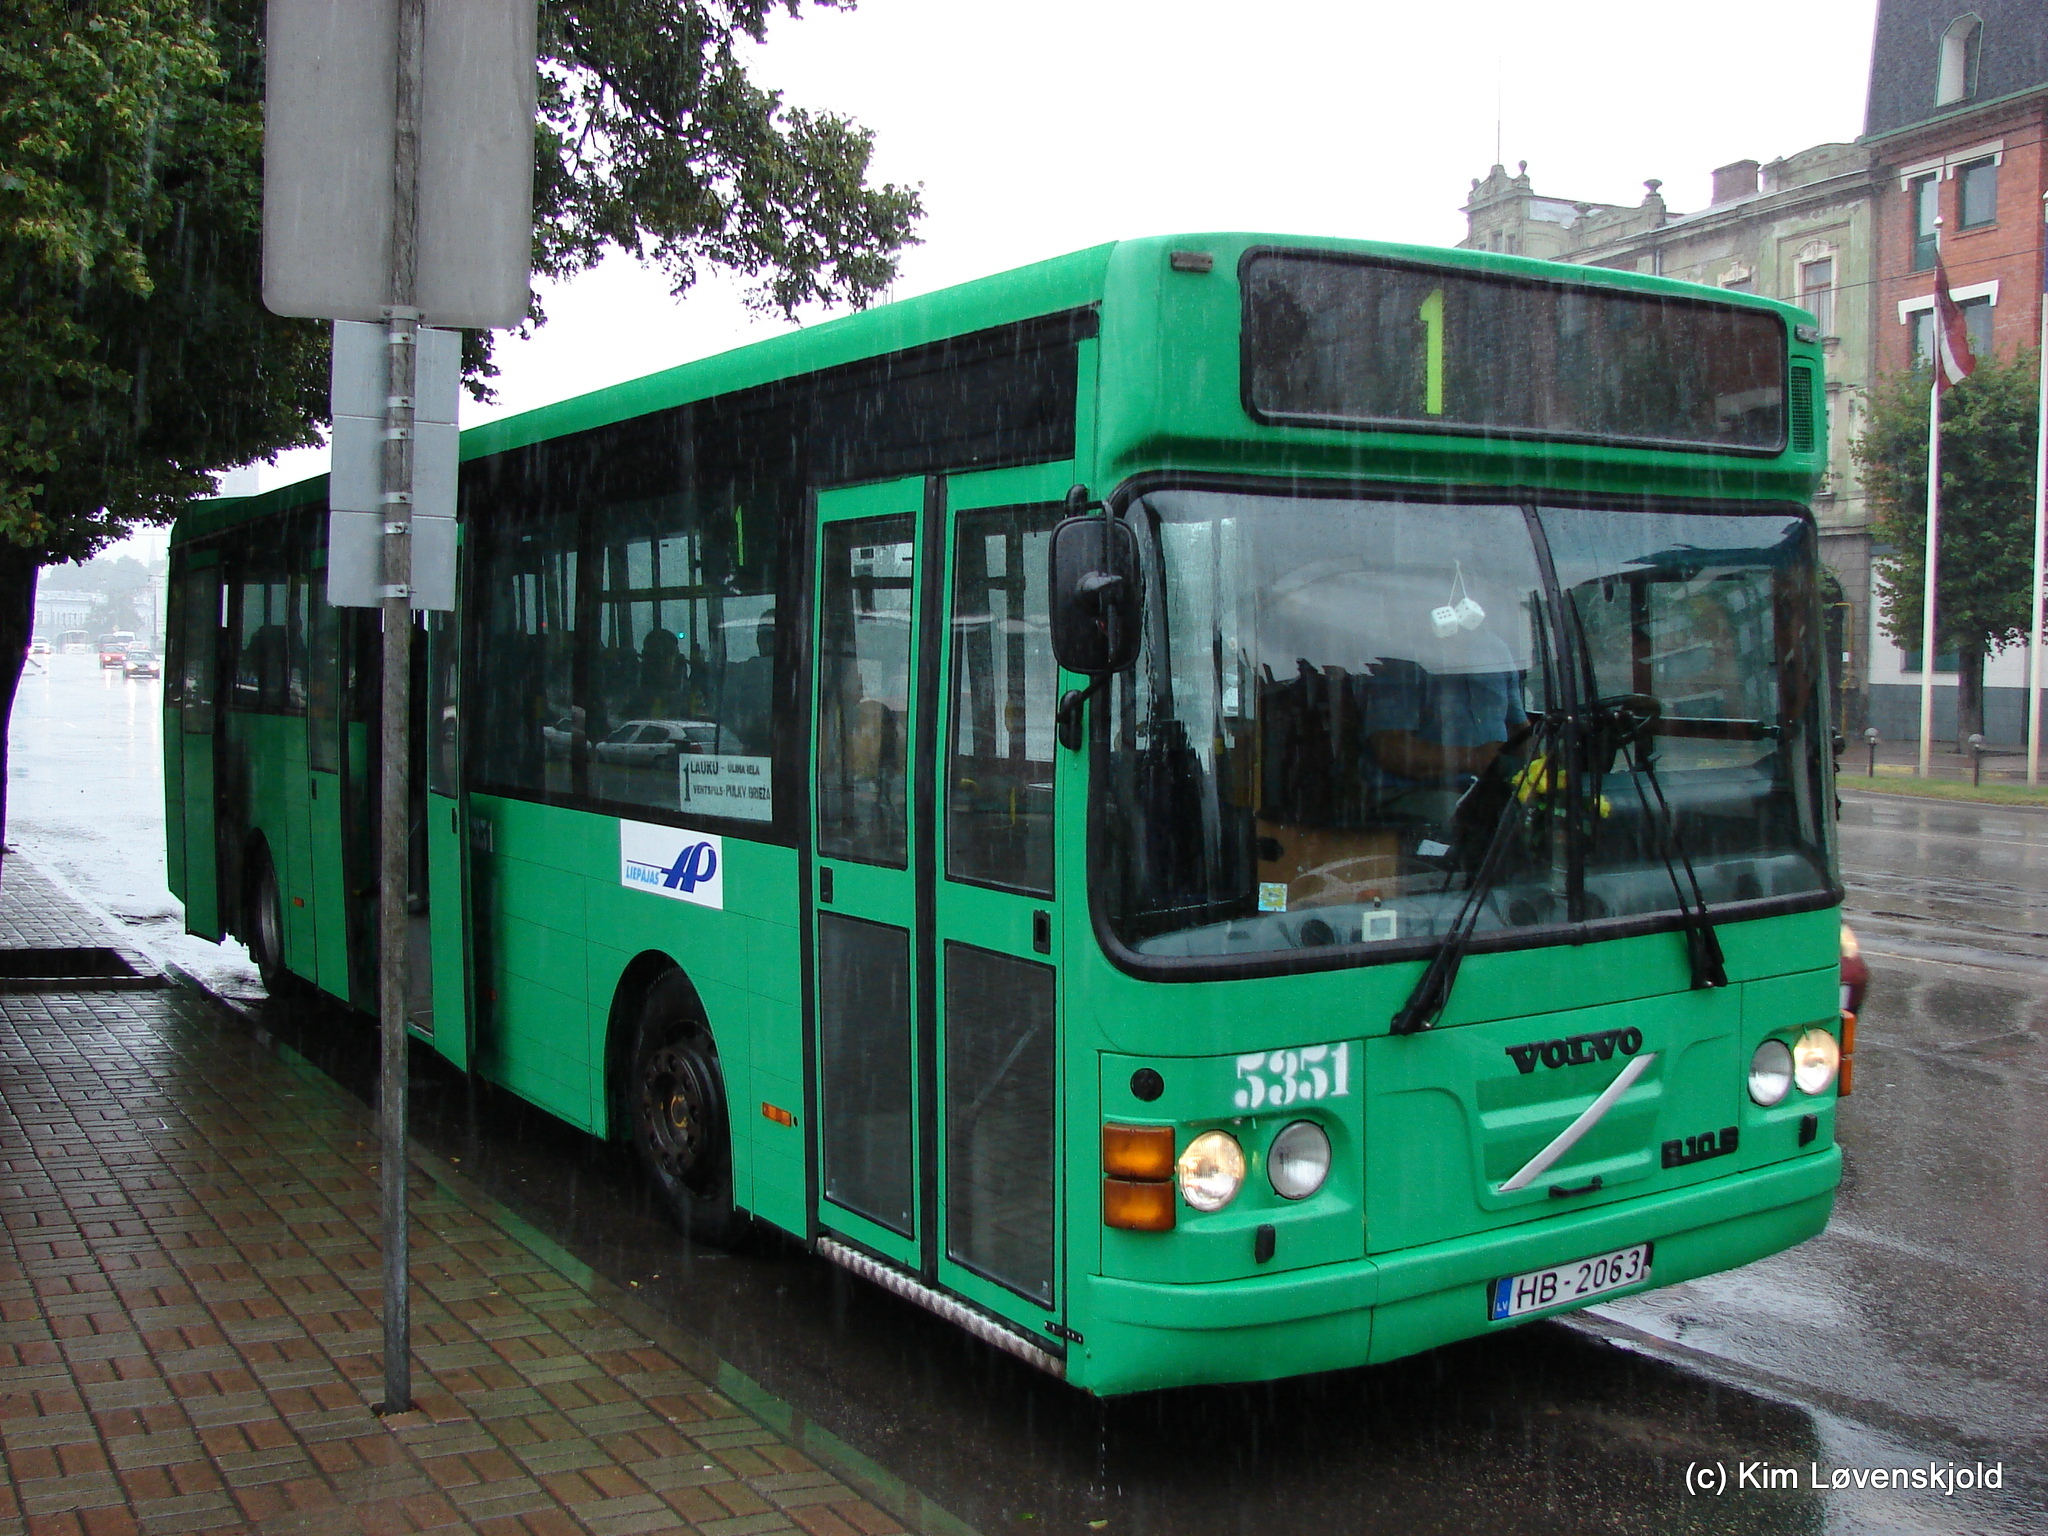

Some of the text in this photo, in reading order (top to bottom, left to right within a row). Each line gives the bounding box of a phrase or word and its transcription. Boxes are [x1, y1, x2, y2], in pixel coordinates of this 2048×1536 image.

[1419, 288, 1443, 415] 1
[683, 762, 691, 802] 1
[690, 760, 719, 775] LAUKU
[1505, 1026, 1643, 1074] VOLVO
[1234, 1042, 1349, 1109] 5351
[1516, 1250, 1640, 1309] HB-2063
[1496, 1301, 1508, 1312] LV
